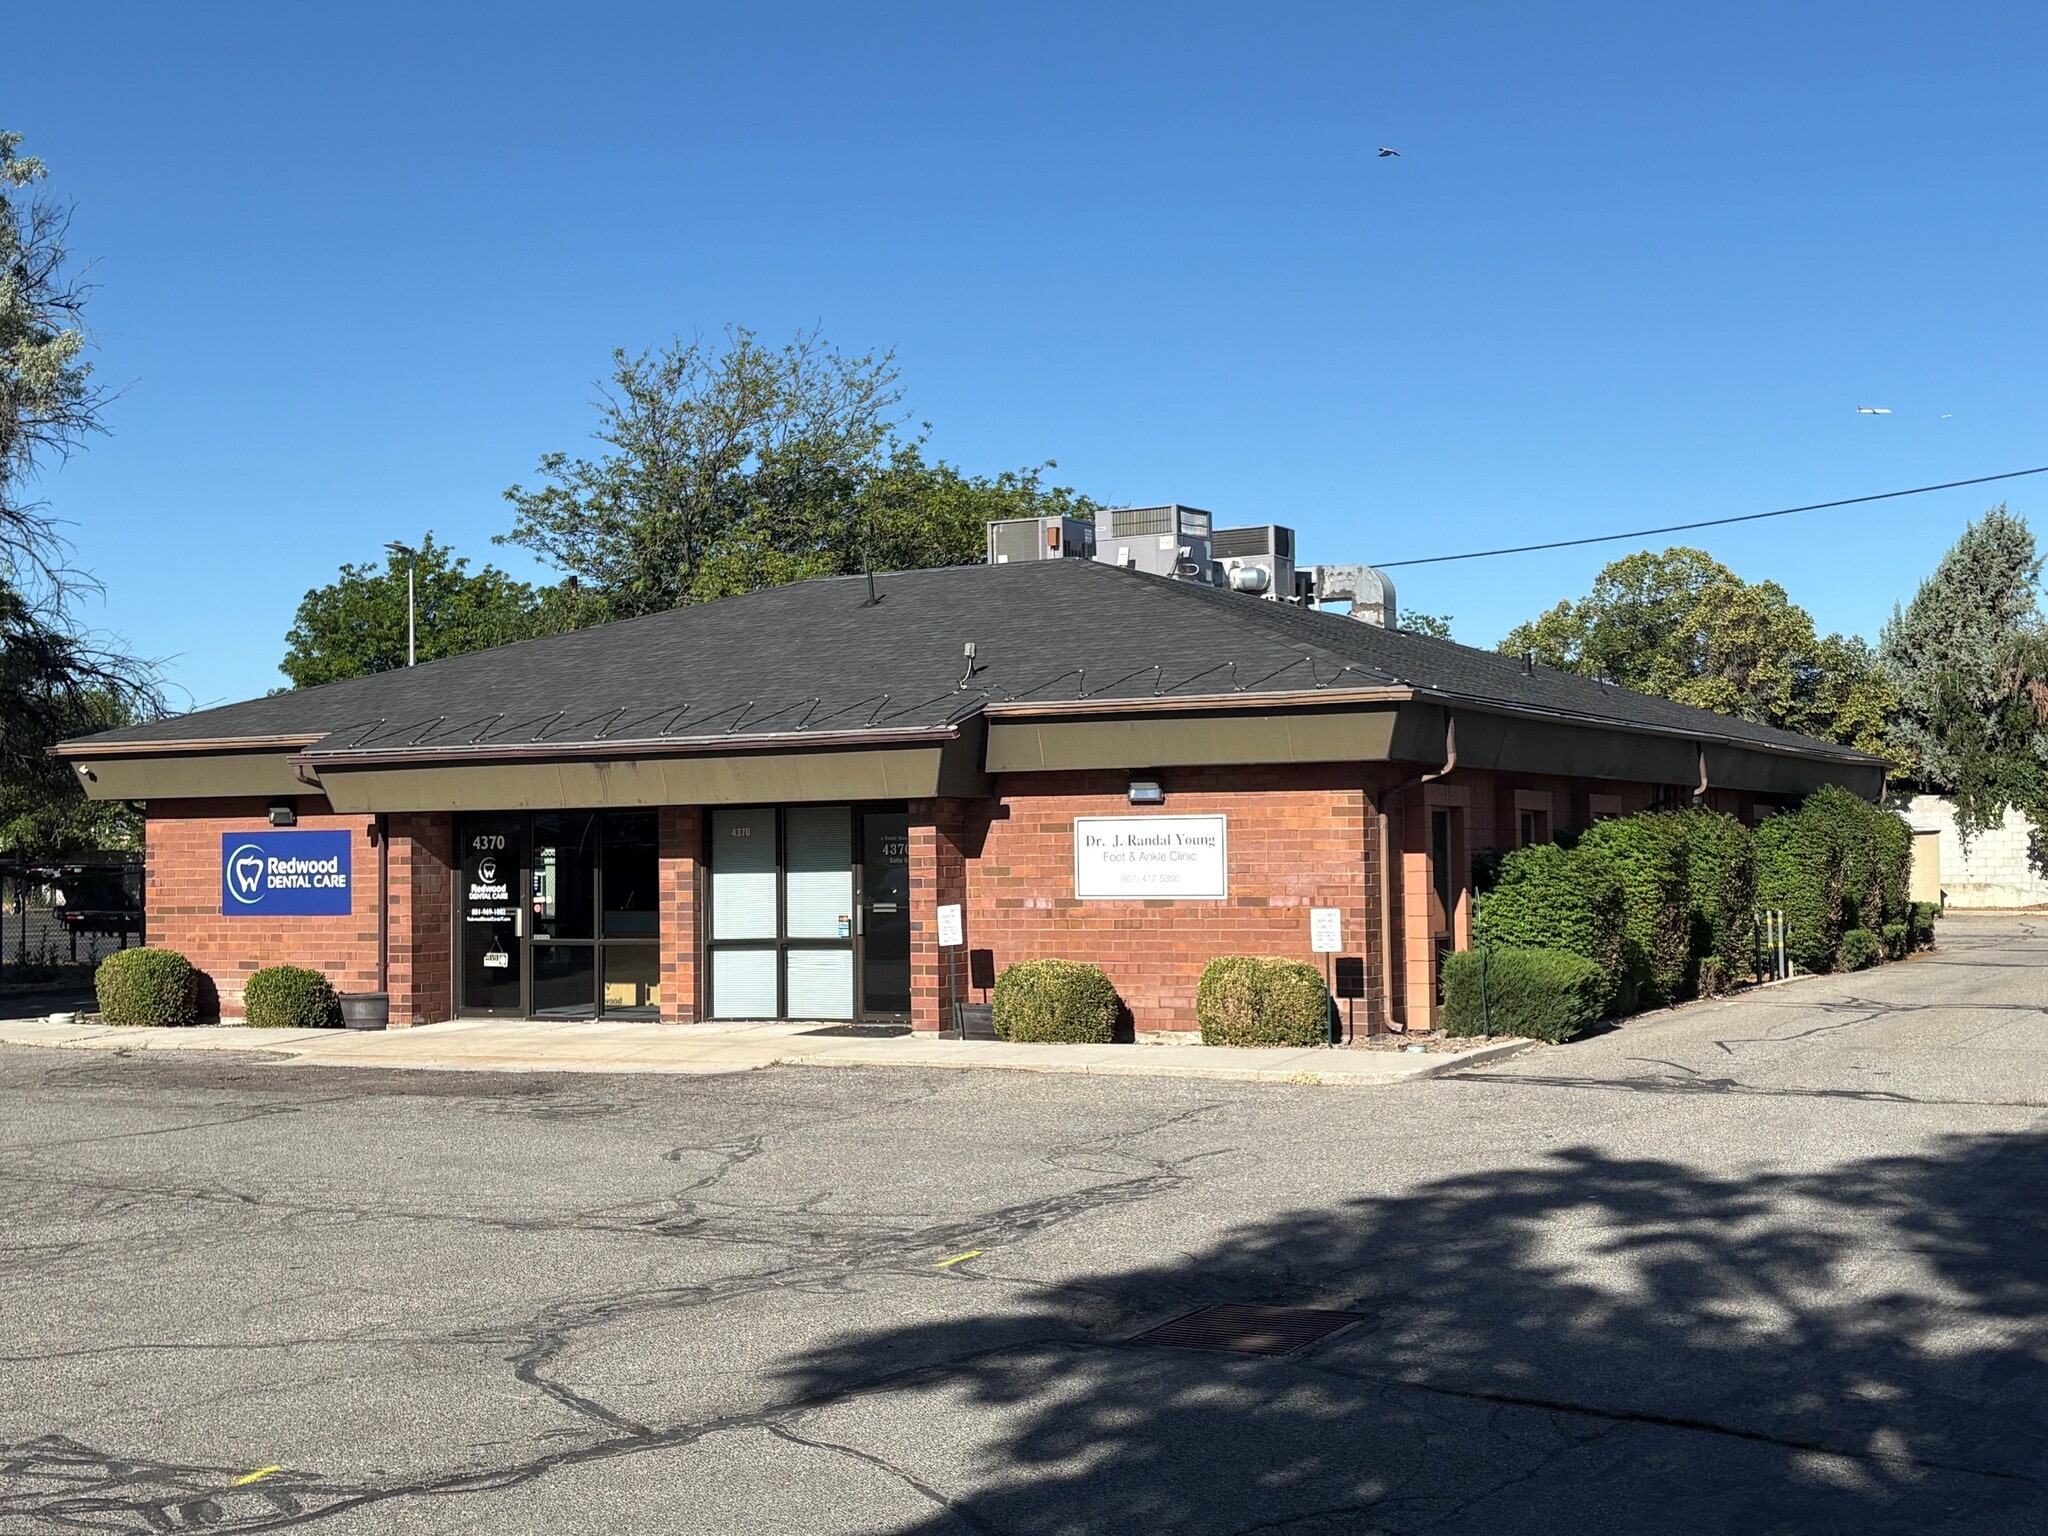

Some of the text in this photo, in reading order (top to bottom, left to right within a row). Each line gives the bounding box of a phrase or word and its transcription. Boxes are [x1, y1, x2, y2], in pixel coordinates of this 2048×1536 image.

[472, 835, 505, 850] 4370
[1086, 833, 1216, 848] Dr. J. Randal Young
[1103, 850, 1198, 863] Foot & Ankle Clinic
[267, 856, 338, 874] Redwood
[267, 874, 346, 889] DENTAL CARE
[471, 884, 506, 893] Redwood
